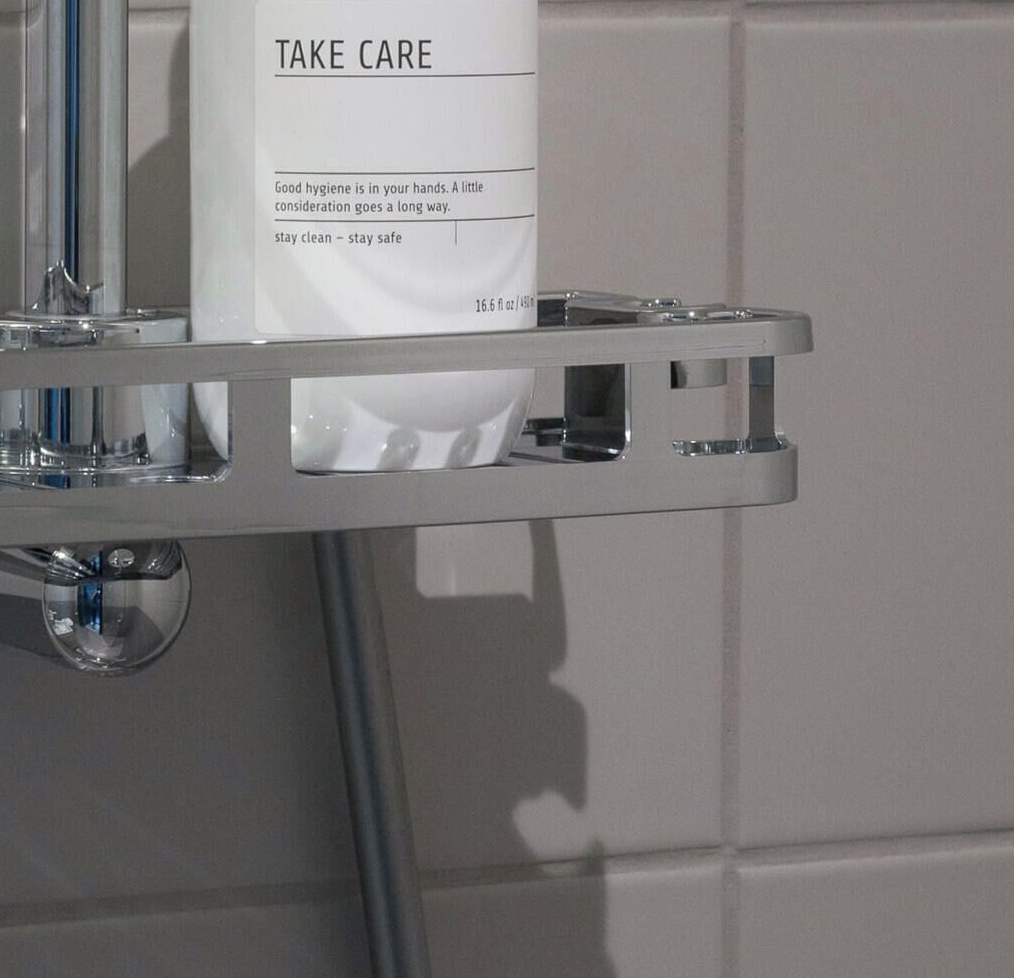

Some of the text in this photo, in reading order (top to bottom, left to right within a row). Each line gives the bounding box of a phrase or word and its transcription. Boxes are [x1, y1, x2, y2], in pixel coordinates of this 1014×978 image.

[274, 38, 433, 70] TAKE CARE
[274, 180, 484, 198] Good hygiene is in your hands. A little
[274, 199, 451, 215] consideration goes a long way.
[273, 231, 298, 246] stay
[300, 230, 332, 245] clean
[348, 231, 374, 247] stay
[377, 230, 403, 245] safe
[475, 297, 496, 313] 16.6
[497, 297, 505, 312] fl
[506, 299, 514, 312] oz
